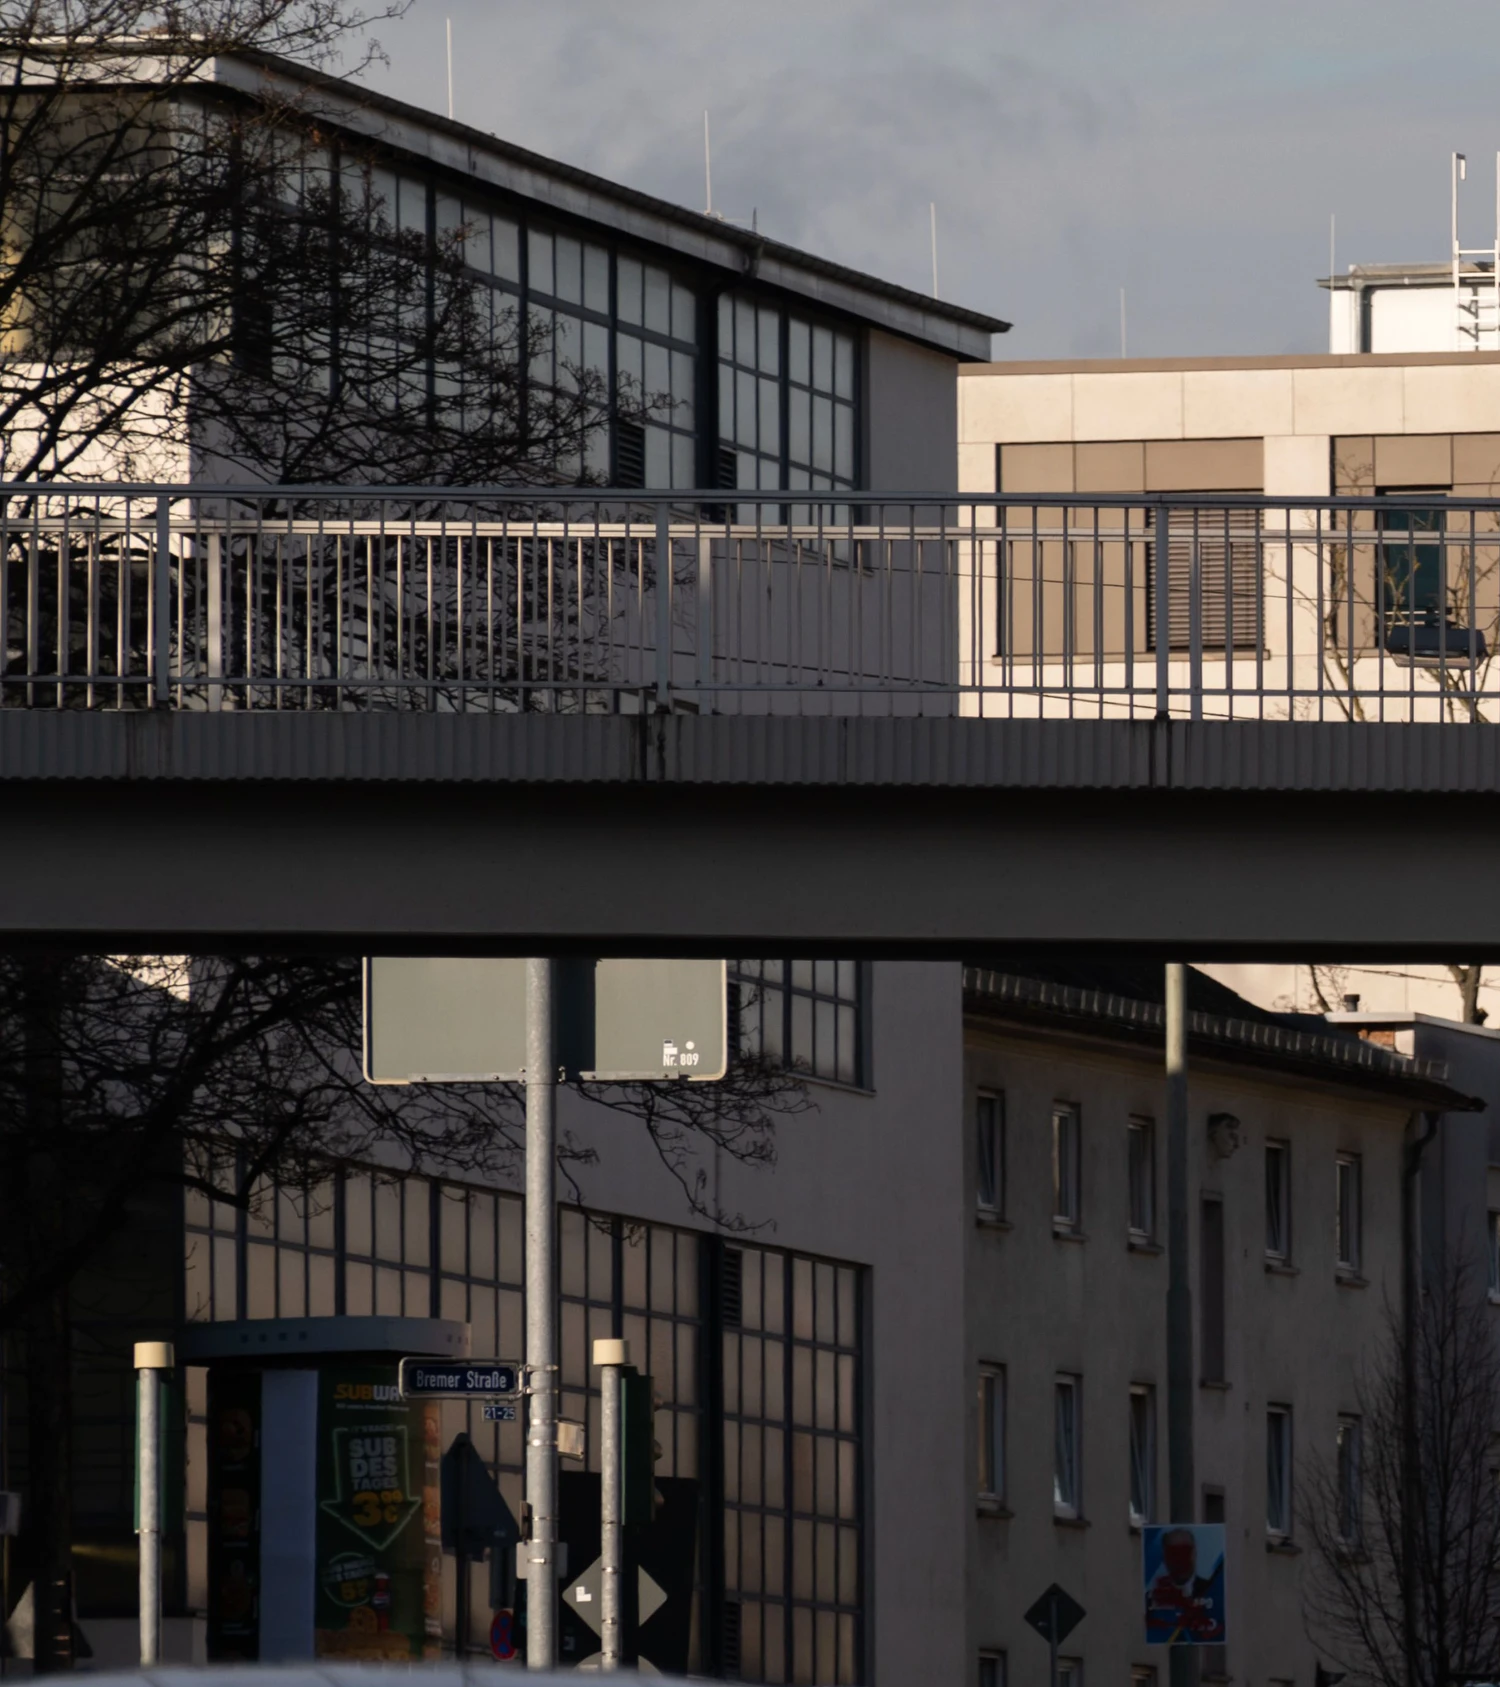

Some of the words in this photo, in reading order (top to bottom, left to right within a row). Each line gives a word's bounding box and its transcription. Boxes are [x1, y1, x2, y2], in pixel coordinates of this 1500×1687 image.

[680, 1053, 699, 1066] 809
[416, 1369, 461, 1389] Bremer
[466, 1369, 508, 1389] Straße
[335, 1383, 401, 1401] SUBWA
[485, 1406, 516, 1421] 21-25
[349, 1436, 398, 1458] SUB
[349, 1456, 399, 1478] DES
[351, 1476, 399, 1491] TAGES
